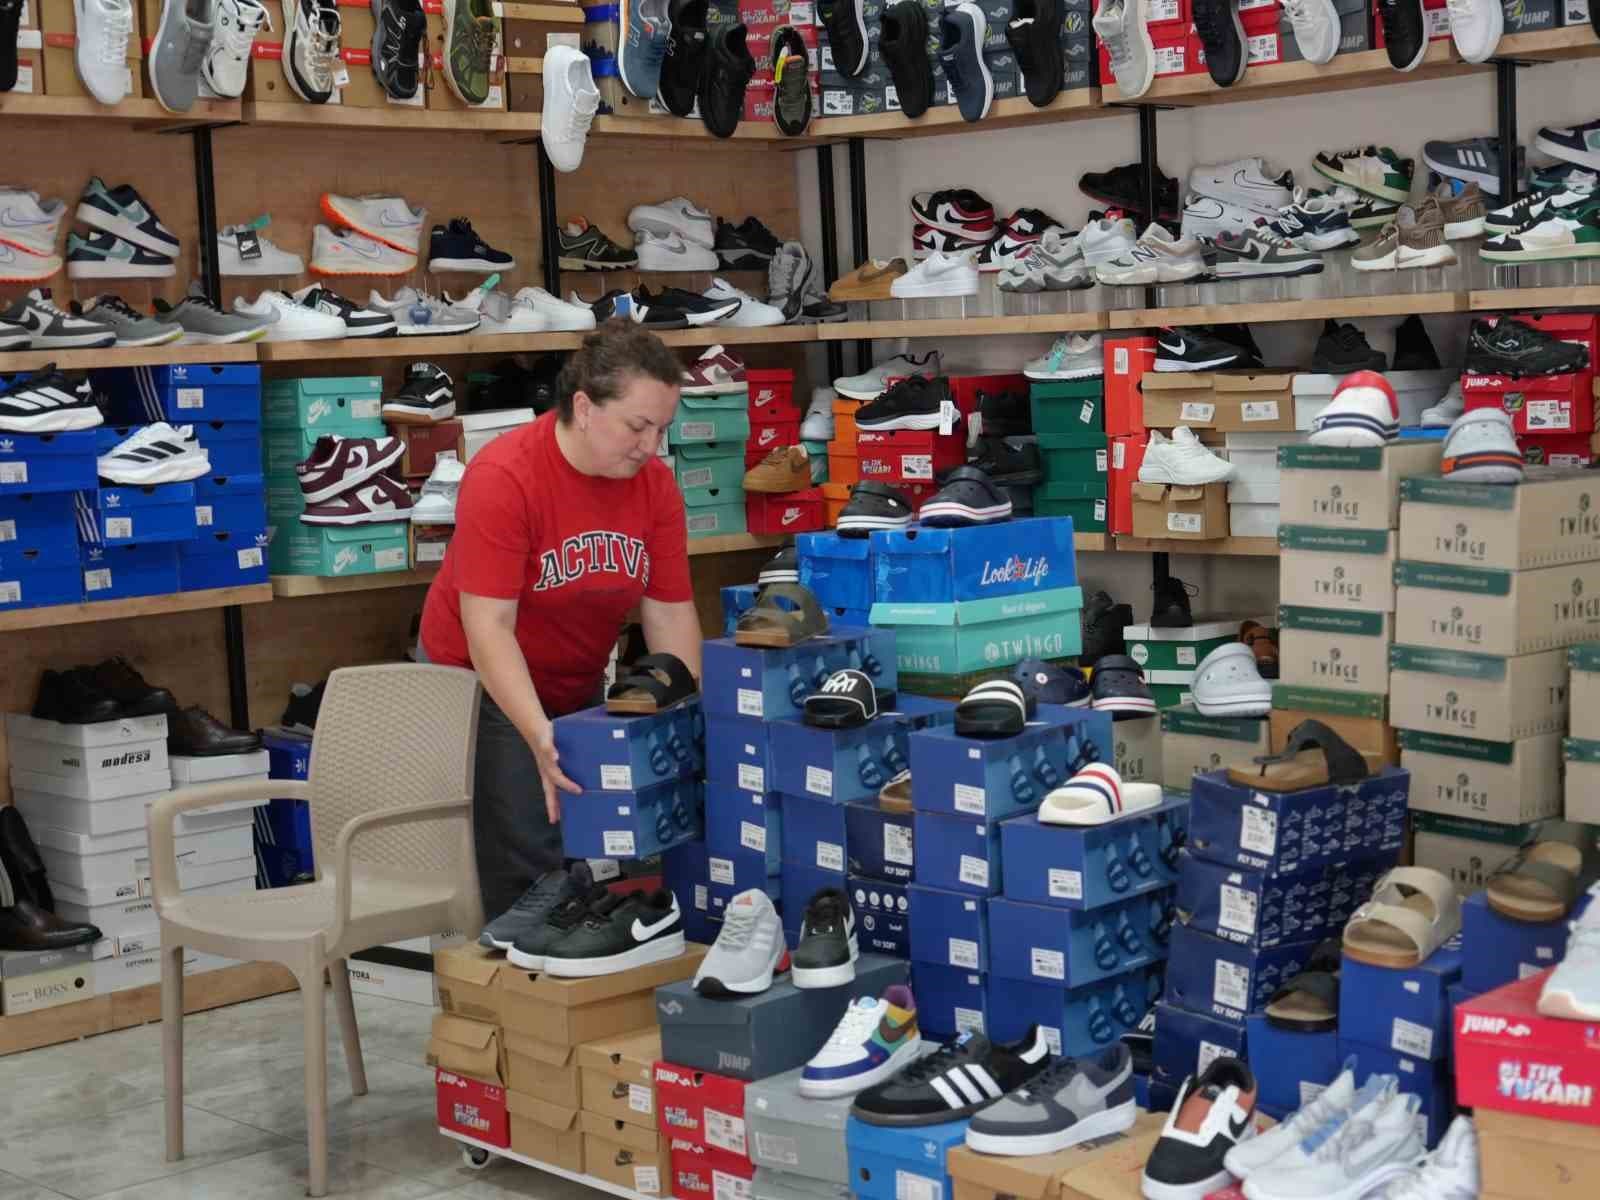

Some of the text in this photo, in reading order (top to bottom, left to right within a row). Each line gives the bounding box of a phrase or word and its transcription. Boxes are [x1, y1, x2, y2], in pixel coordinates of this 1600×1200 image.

[1064, 70, 1085, 82] UMP
[1559, 513, 1600, 537] TWING
[1024, 555, 1048, 586] Life
[1461, 1013, 1508, 1034] JUMP
[718, 1052, 751, 1071] JUMP
